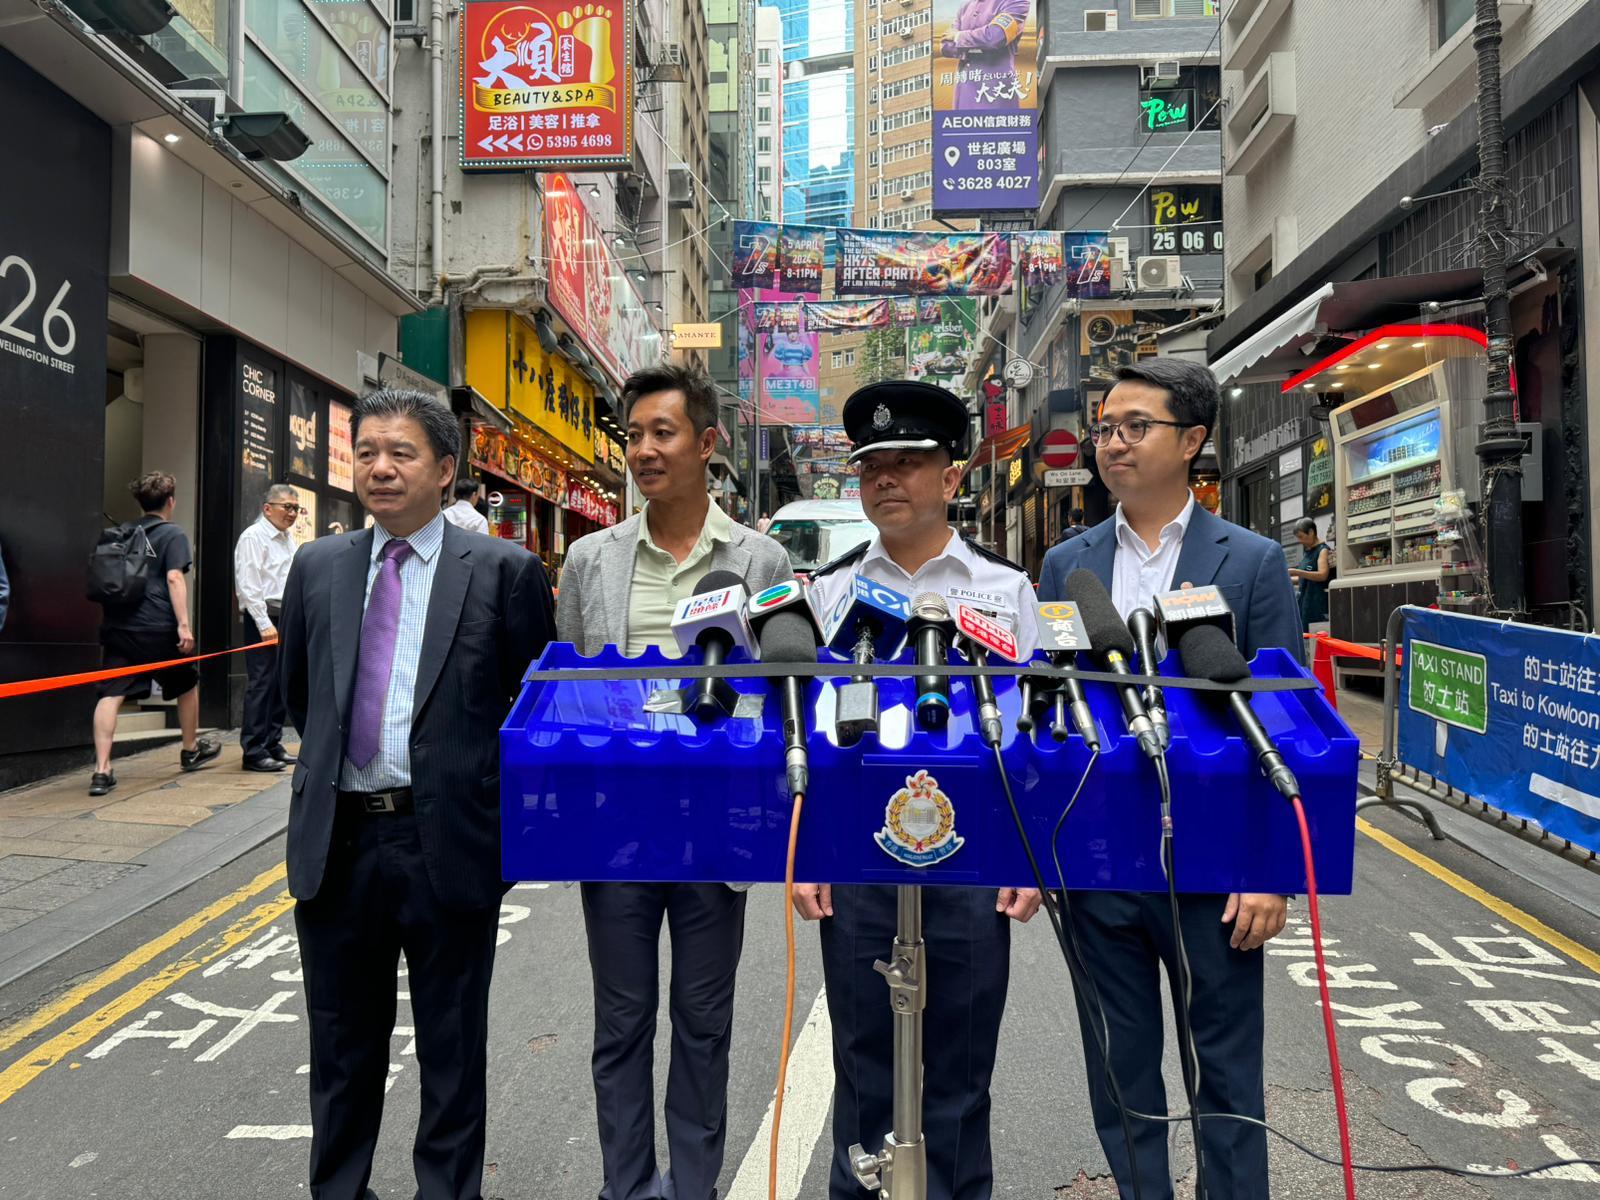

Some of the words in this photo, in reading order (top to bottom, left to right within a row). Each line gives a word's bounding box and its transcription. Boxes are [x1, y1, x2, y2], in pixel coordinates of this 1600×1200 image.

[472, 22, 561, 90] 大順
[493, 89, 594, 106] BEAUTY&SPA
[942, 115, 1031, 129] AEON信貸財務
[546, 136, 577, 148] 5395
[580, 134, 612, 147] 4698
[967, 141, 1026, 156] 世紀廣場
[976, 158, 1016, 171] 803室
[957, 177, 993, 190] 3628
[996, 176, 1032, 189] 4027
[795, 239, 819, 250] APRIL
[1153, 231, 1176, 250] 25
[1182, 231, 1205, 250] 06
[786, 267, 818, 279] 8-11PM
[843, 267, 881, 280] AFTER
[884, 267, 924, 281] PARTY
[0, 255, 76, 356] 26
[50, 357, 76, 374] STREET
[243, 364, 263, 384] CHIC
[242, 379, 276, 405] CORNER
[960, 589, 993, 601] POLICE
[1046, 618, 1078, 647] 商台
[1412, 650, 1438, 674] TAXI
[1440, 658, 1483, 685] STAND
[1524, 654, 1600, 696] 的士站往
[1422, 679, 1470, 716] 的士站
[1490, 682, 1518, 707] Taxi
[1521, 690, 1535, 711] to
[1537, 696, 1600, 731] Kowloon
